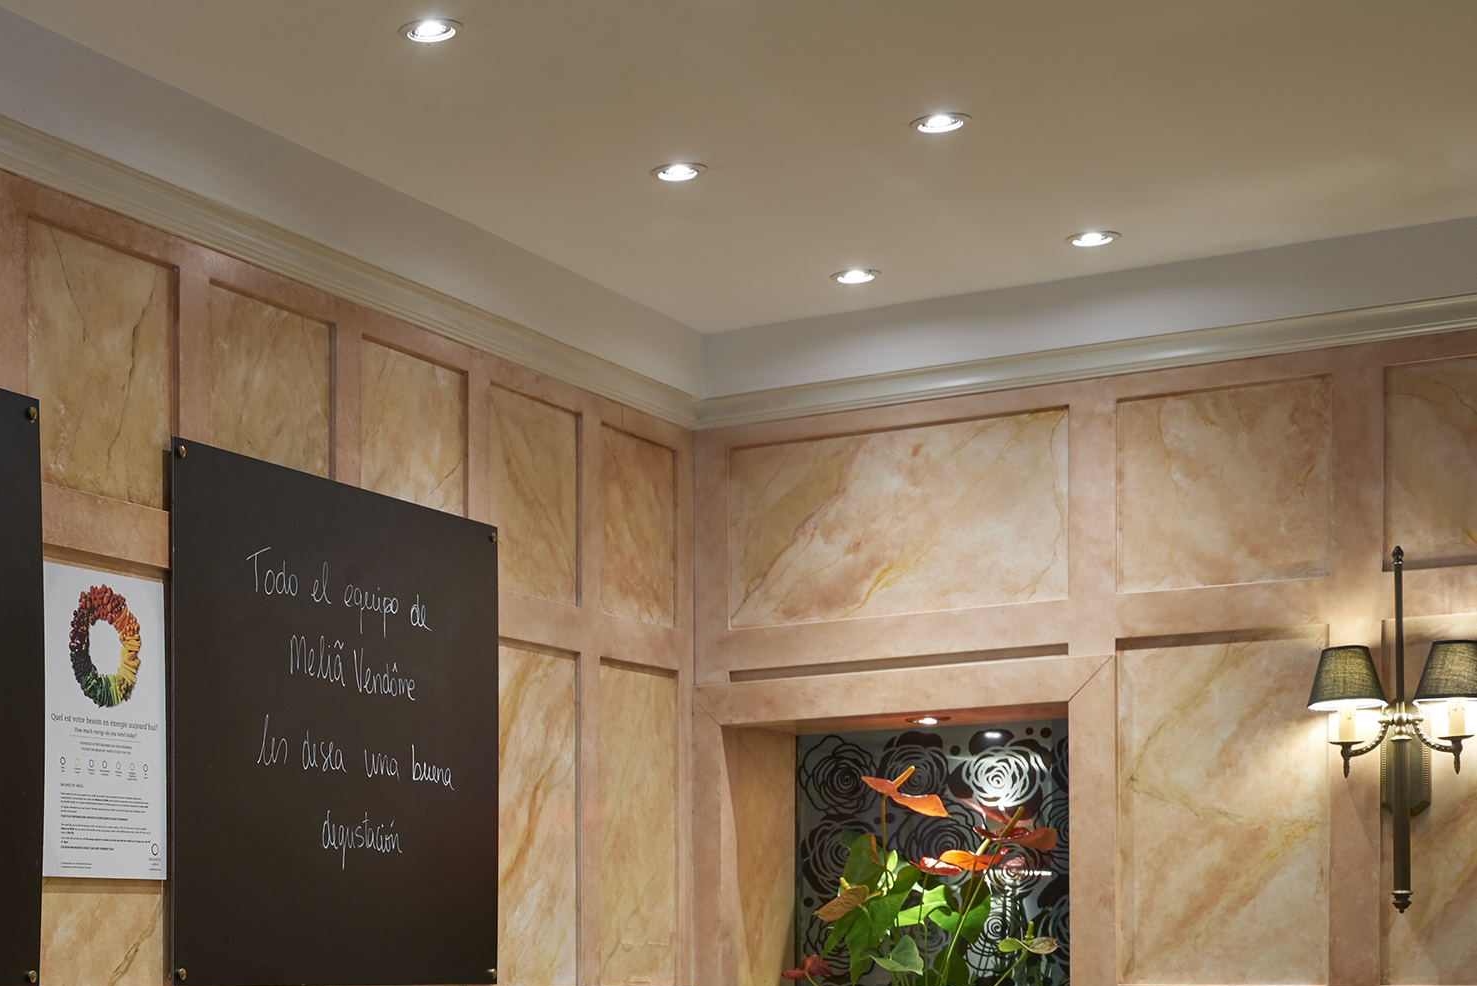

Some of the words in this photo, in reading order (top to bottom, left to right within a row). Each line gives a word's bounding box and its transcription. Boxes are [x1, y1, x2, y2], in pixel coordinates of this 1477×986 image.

[246, 546, 299, 597] Todo
[311, 561, 333, 605] el
[343, 584, 400, 639] equipo
[410, 593, 433, 632] de
[353, 648, 416, 701] Vendôme
[50, 712, 64, 722] Quel
[64, 715, 72, 723] est
[72, 716, 85, 724] votre
[86, 716, 102, 726] besoin
[301, 730, 348, 773] desea
[364, 749, 401, 781] una
[411, 744, 456, 791] buena
